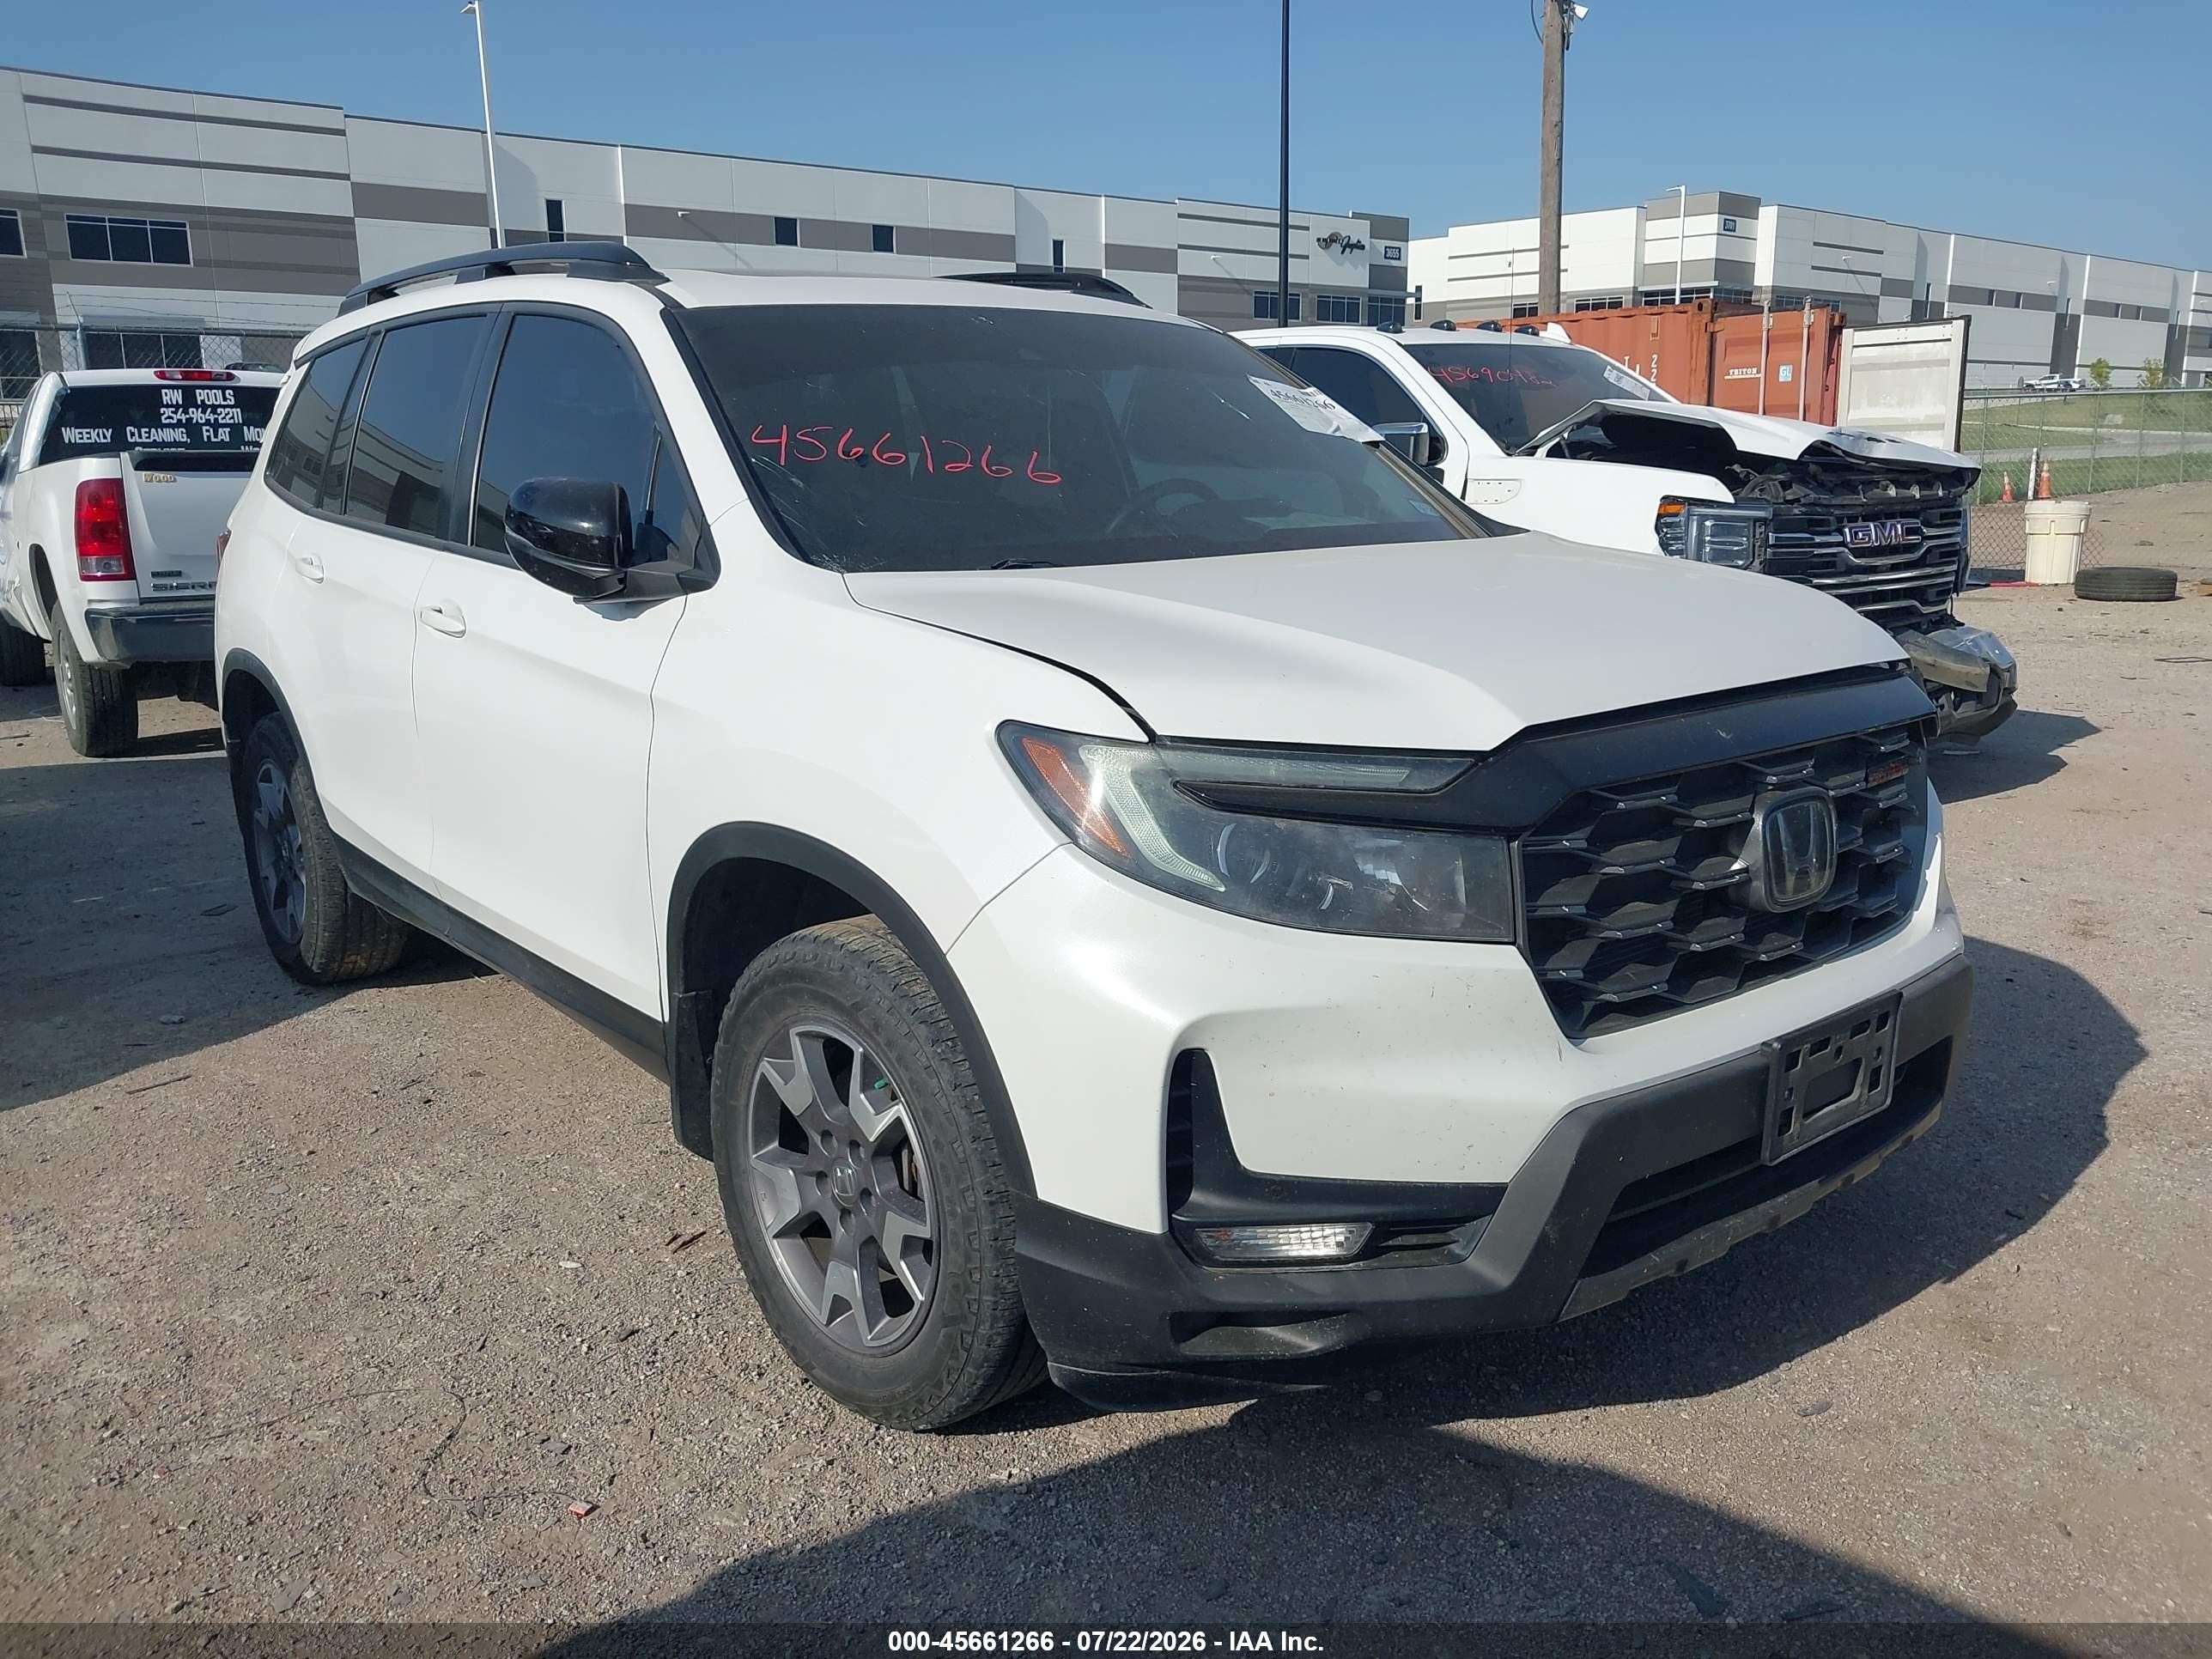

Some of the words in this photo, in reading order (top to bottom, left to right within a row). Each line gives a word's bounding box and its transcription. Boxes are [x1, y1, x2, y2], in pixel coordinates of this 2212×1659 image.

[161, 389, 182, 405] RW
[196, 389, 235, 405] POOLS
[160, 407, 243, 424] 254-964-2211
[750, 424, 1063, 485] 45661266
[1844, 520, 1923, 547] GMC
